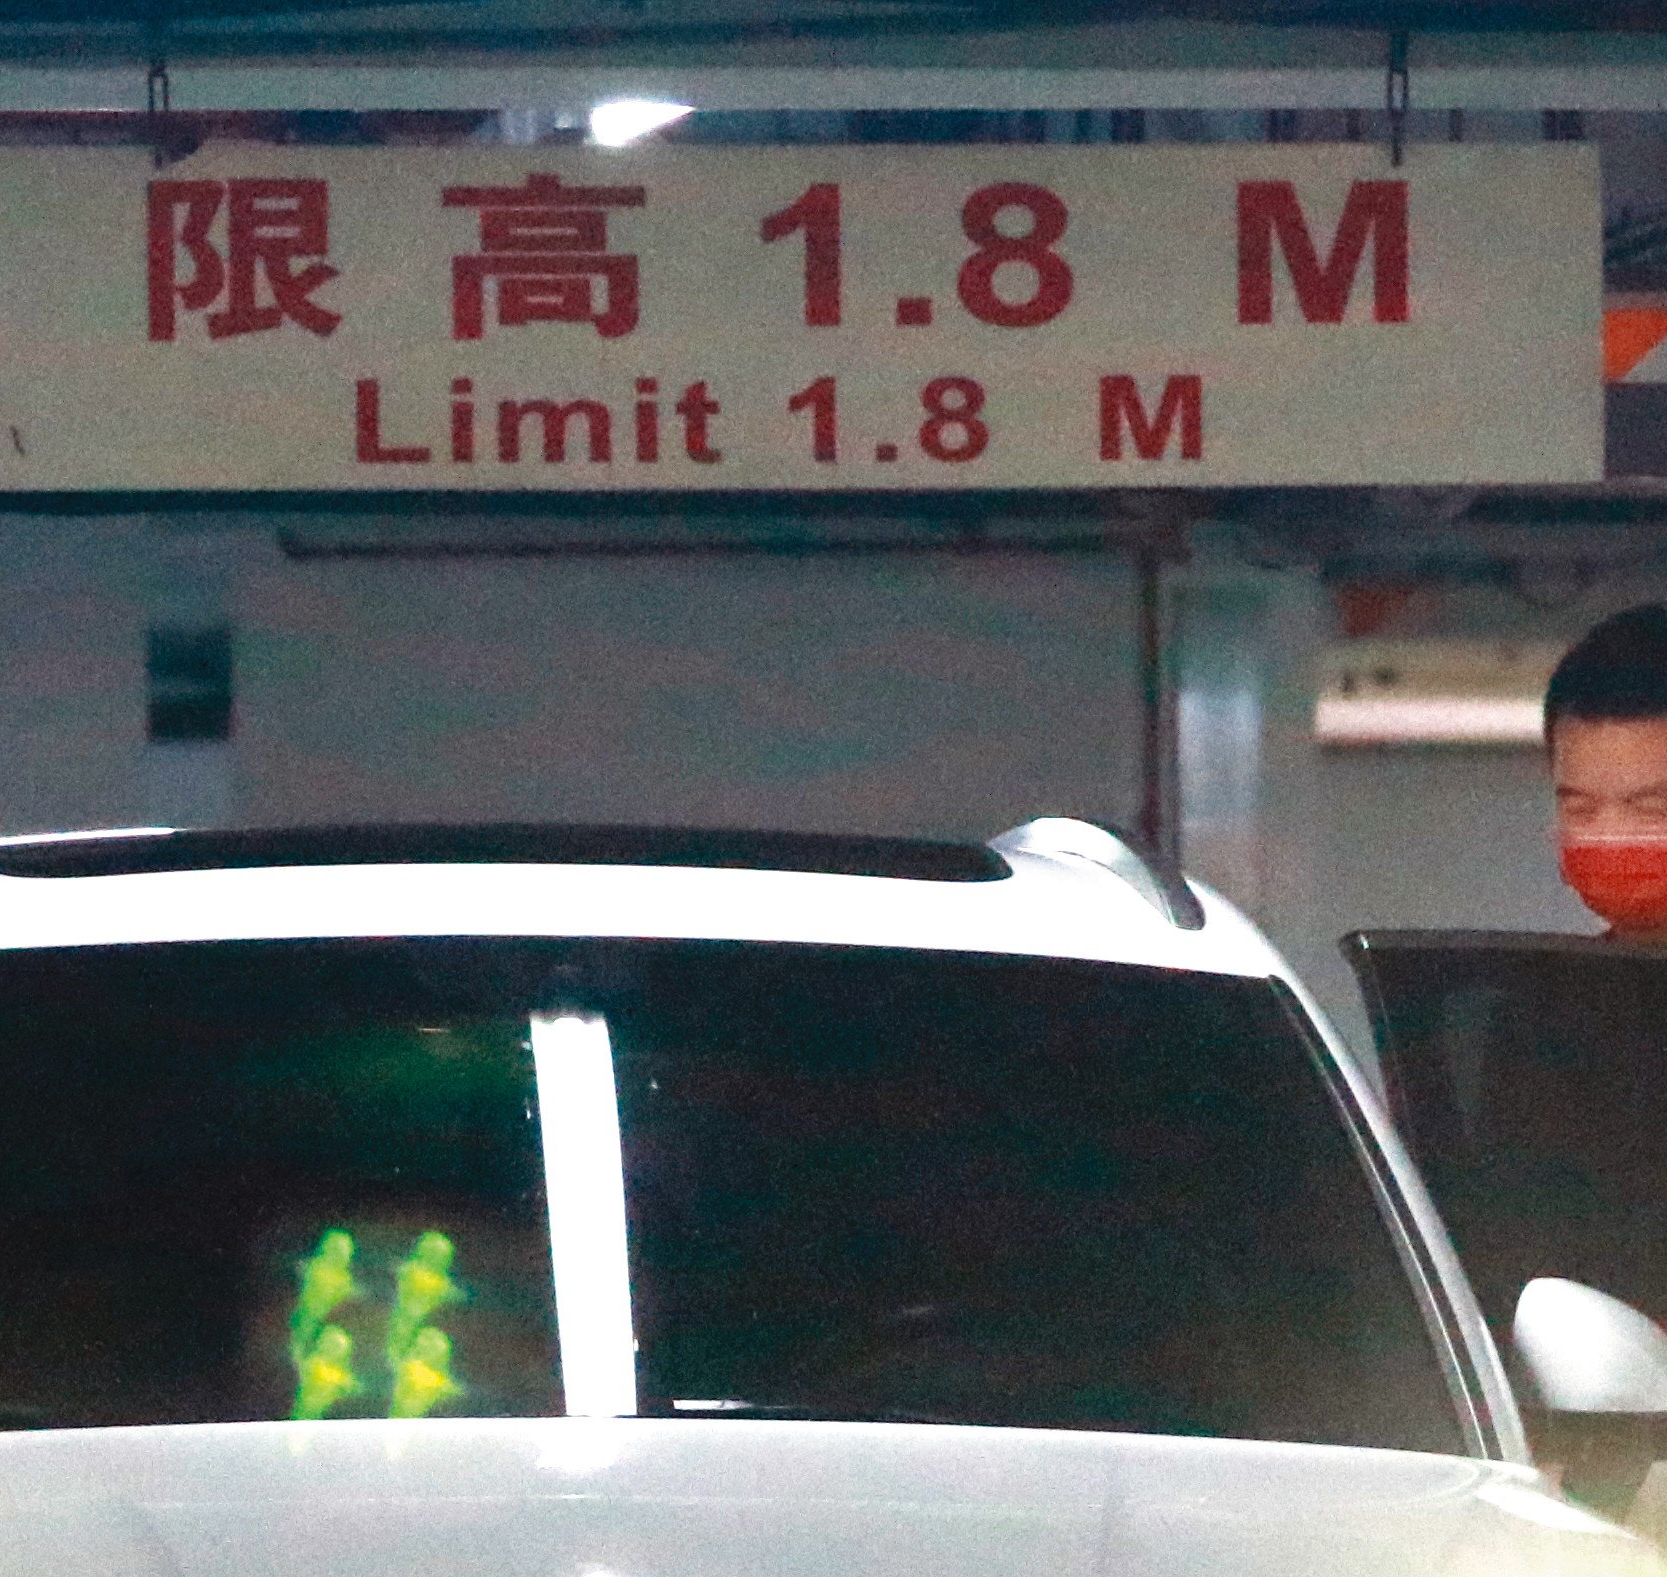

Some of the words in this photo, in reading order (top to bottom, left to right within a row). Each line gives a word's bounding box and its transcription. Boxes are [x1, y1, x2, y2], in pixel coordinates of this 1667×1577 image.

[146, 174, 646, 341] 限高
[758, 180, 1075, 328] 1.8
[1236, 180, 1411, 323] M
[353, 375, 722, 464] Limit
[787, 375, 992, 464] 1.8
[1098, 375, 1204, 461] M
